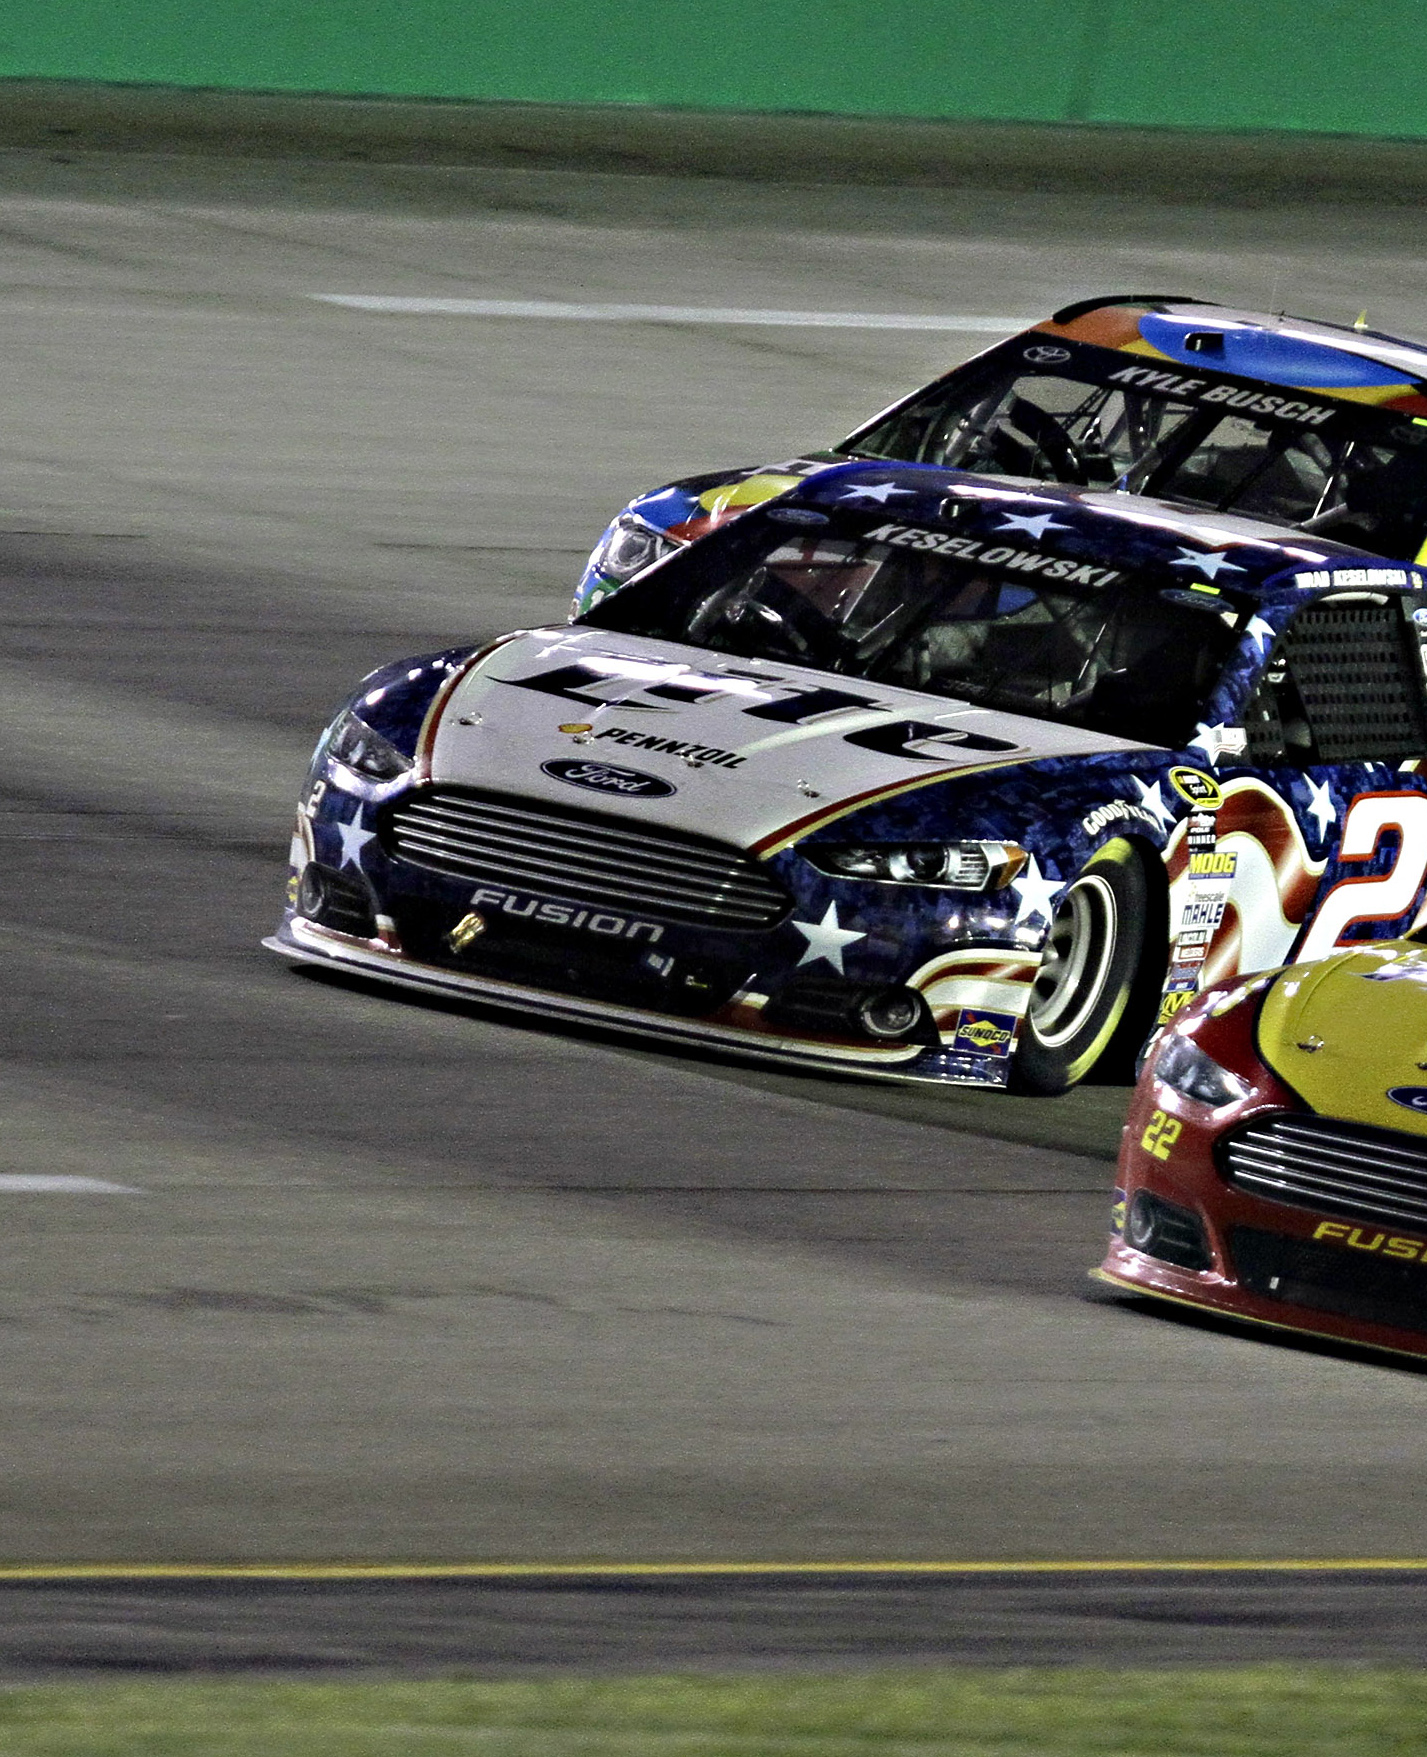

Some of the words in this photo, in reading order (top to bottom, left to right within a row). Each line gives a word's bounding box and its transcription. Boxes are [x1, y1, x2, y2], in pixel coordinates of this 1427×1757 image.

[1108, 365, 1205, 396] KYLE
[1201, 385, 1336, 425] BUSCH
[863, 523, 1123, 588] KESELOWSKI
[594, 727, 747, 769] PENNZOIL
[565, 763, 650, 792] Ford
[1189, 853, 1237, 874] MOOG
[469, 887, 665, 943] FUSION
[1182, 903, 1225, 925] MAHLE
[960, 1026, 1008, 1042] SUNOCO
[1141, 1109, 1183, 1161] 22
